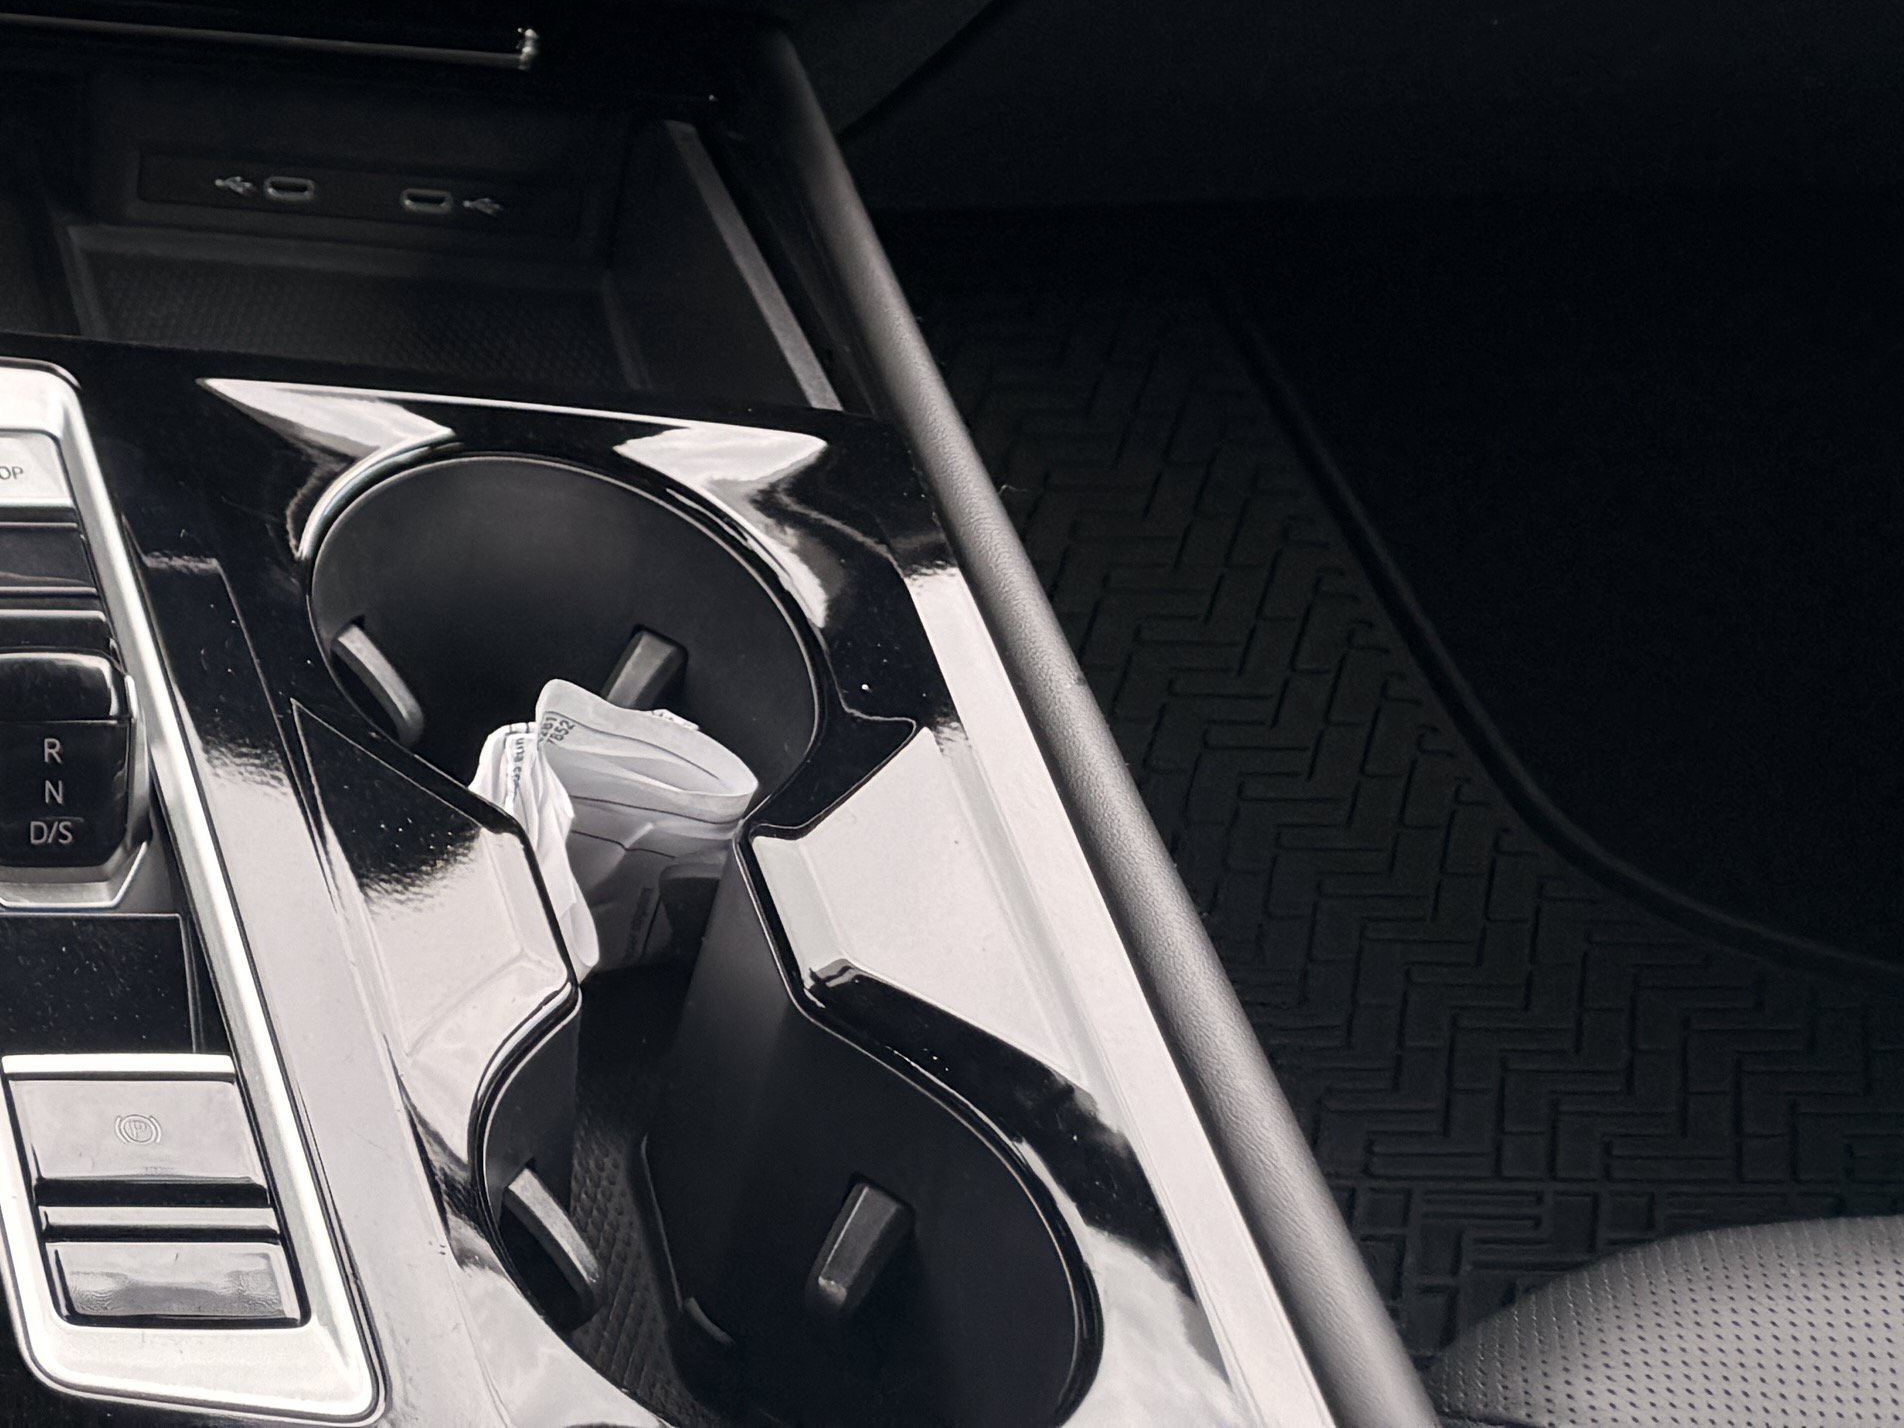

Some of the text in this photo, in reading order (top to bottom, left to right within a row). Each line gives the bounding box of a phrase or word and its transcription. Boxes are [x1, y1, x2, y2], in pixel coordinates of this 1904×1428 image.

[44, 738, 61, 763] R
[45, 780, 63, 804] N
[30, 821, 74, 845] D/S
